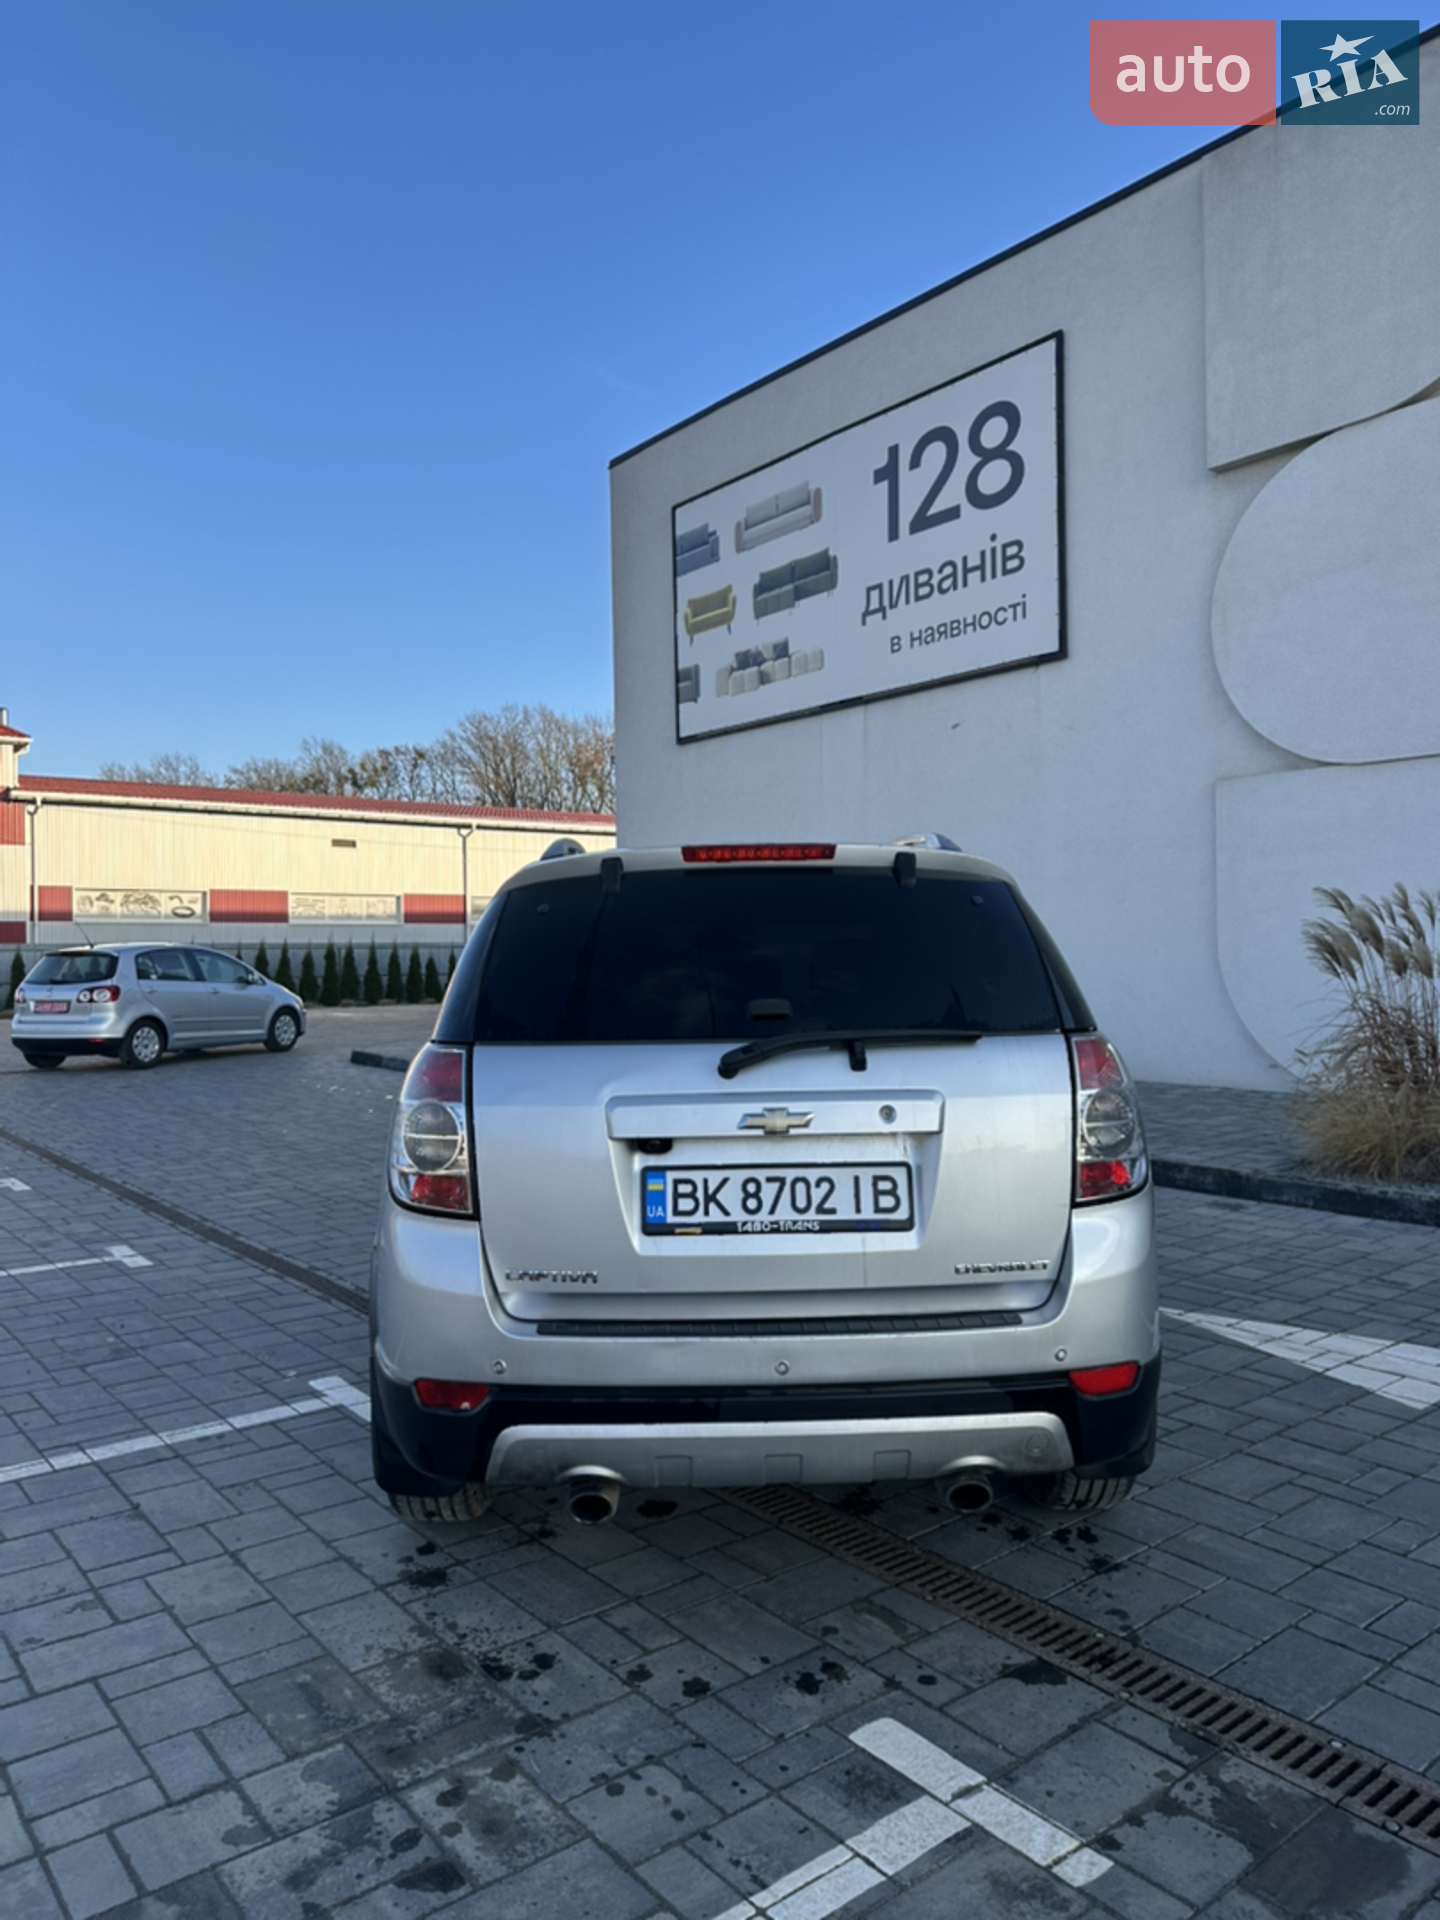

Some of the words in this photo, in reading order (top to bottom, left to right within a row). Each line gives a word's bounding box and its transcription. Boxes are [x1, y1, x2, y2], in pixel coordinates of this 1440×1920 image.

[872, 400, 1026, 544] 128
[861, 533, 1026, 626] диванів
[889, 633, 903, 654] в
[909, 594, 1028, 649] наявності
[646, 1205, 665, 1218] UA
[671, 1176, 732, 1218] BK
[740, 1175, 838, 1216] 8702
[853, 1174, 902, 1215] IB
[505, 1269, 598, 1284] CAPTIVA
